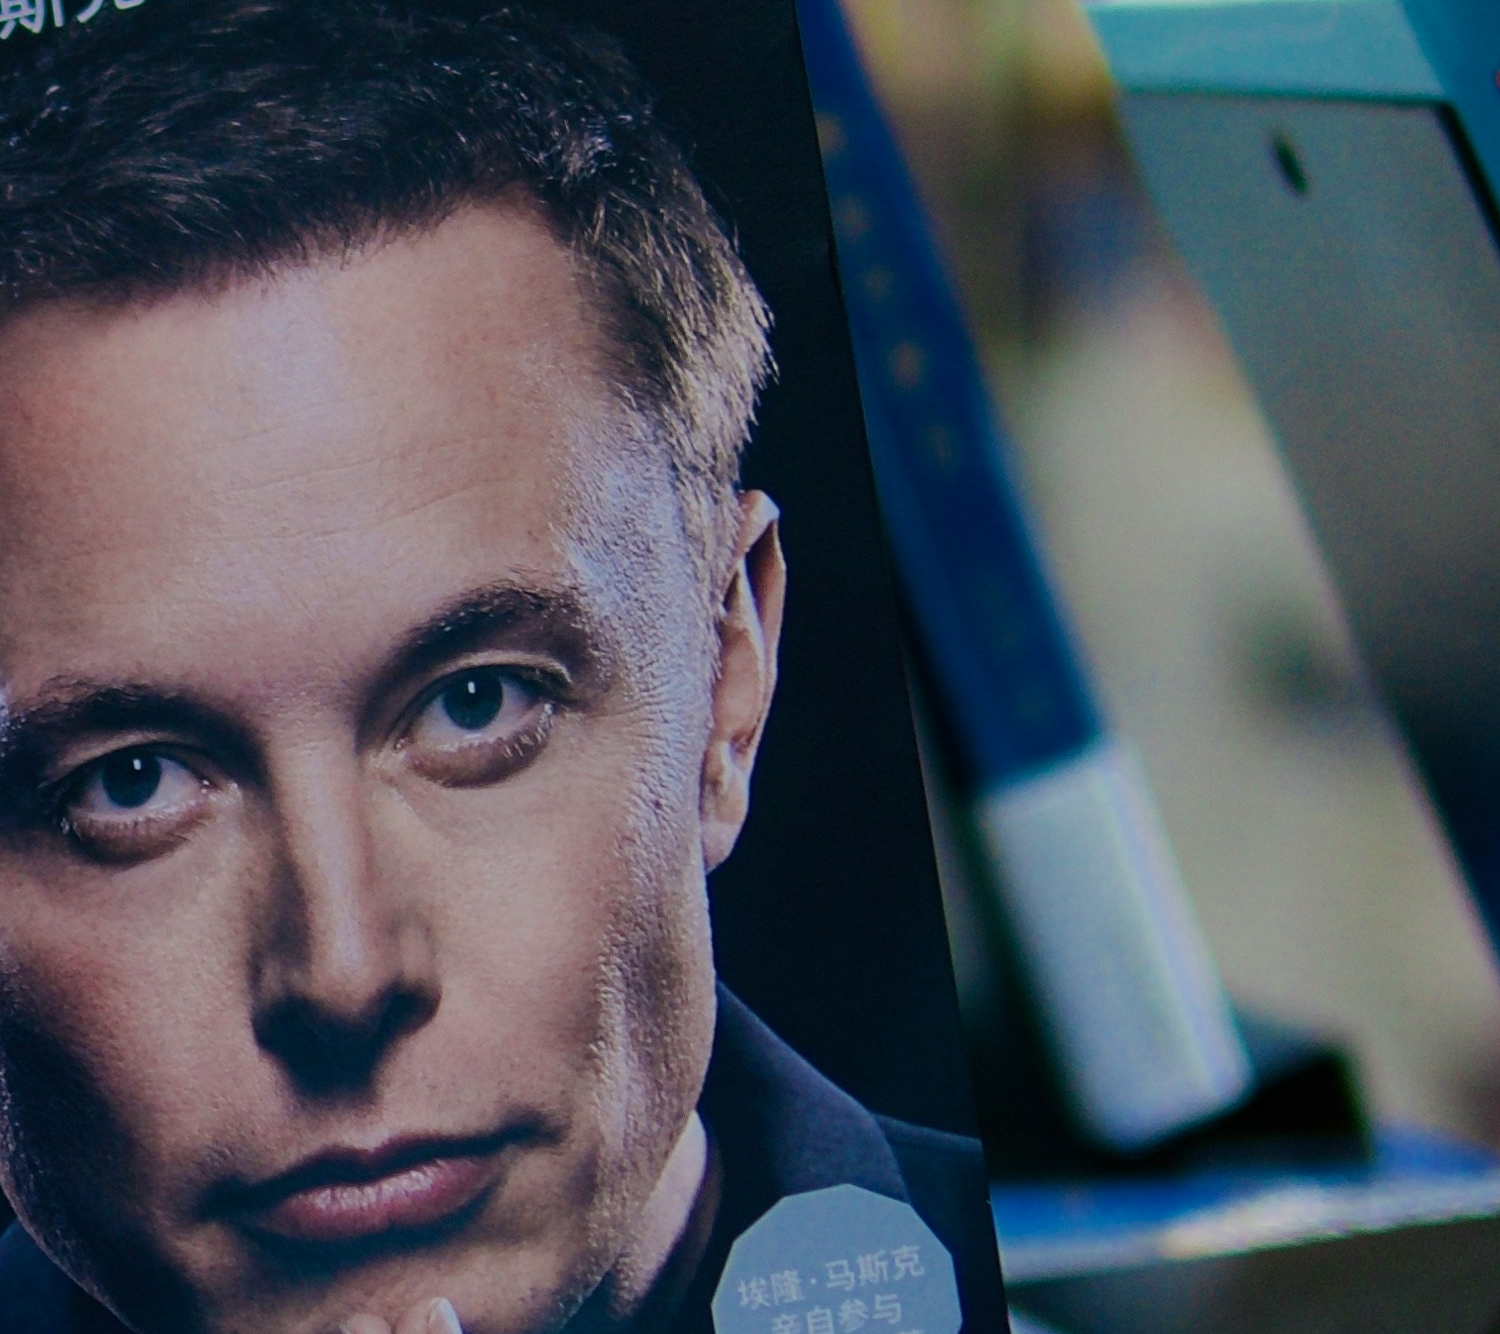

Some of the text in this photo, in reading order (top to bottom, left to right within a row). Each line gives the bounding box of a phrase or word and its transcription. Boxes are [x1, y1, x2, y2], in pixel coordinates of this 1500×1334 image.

[737, 1245, 926, 1312] 埃隆·马斯克
